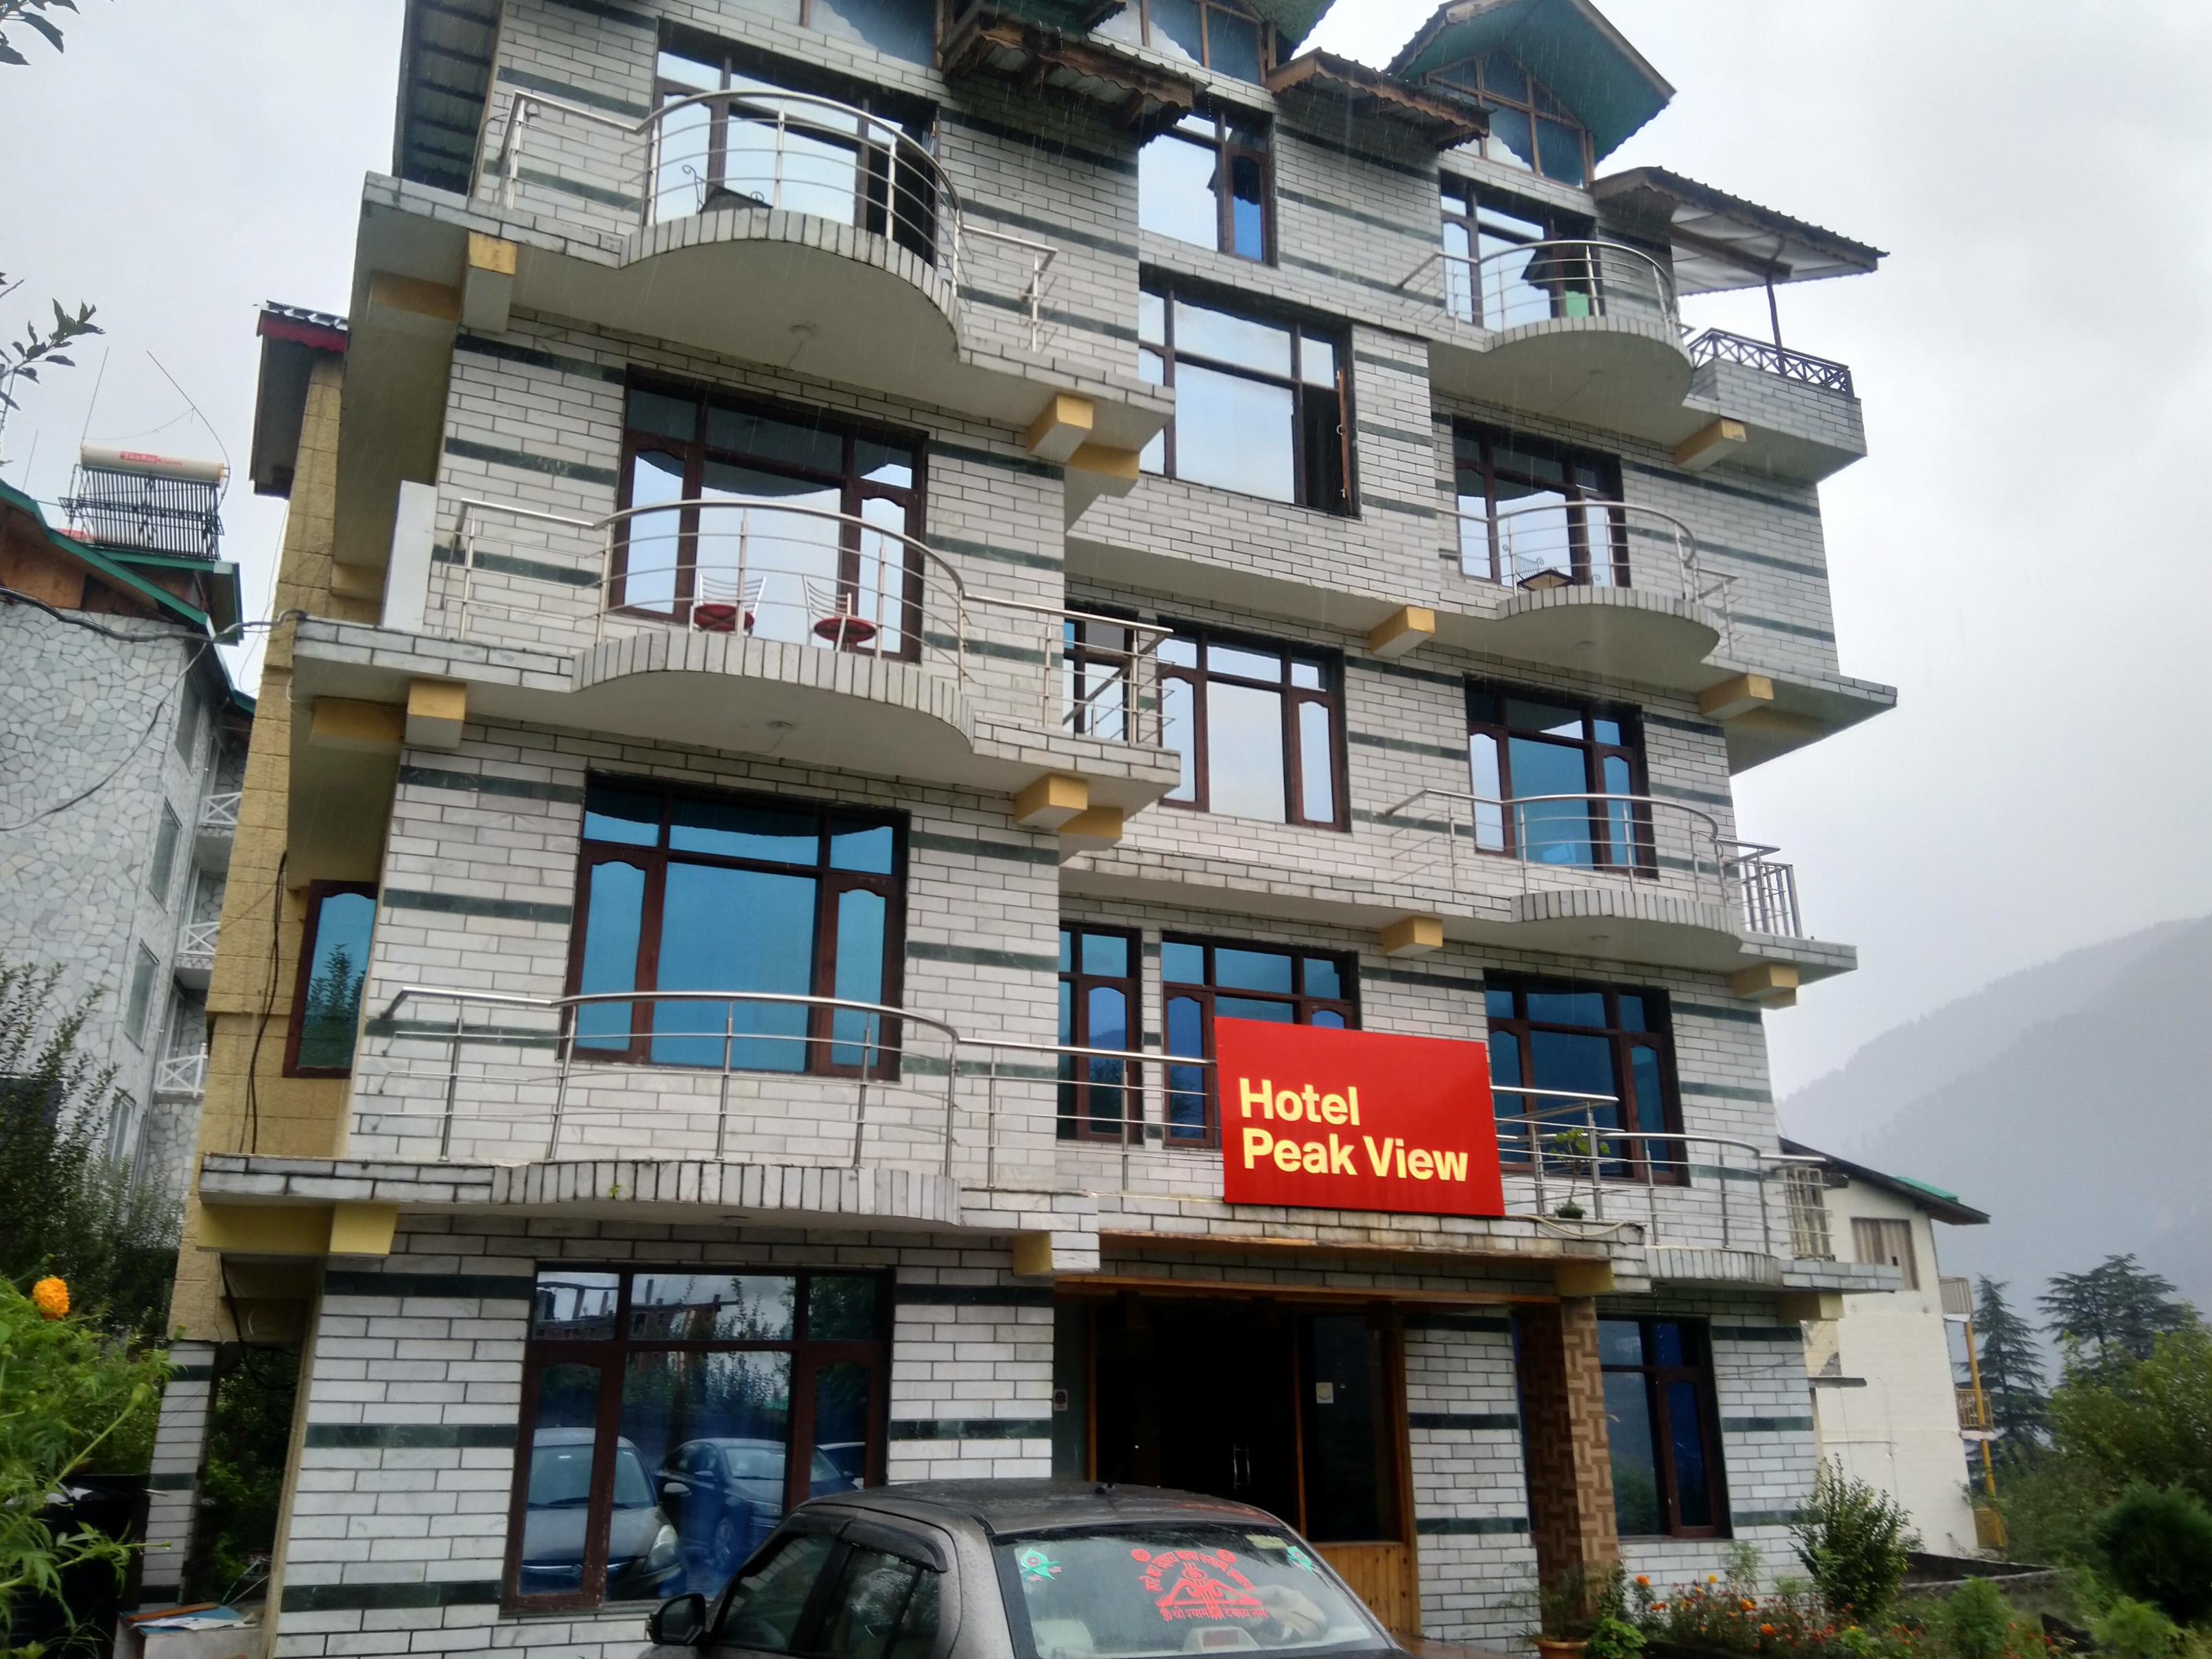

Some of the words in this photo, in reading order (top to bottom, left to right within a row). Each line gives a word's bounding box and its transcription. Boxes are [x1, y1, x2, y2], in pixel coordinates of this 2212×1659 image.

[1239, 1077, 1360, 1125] Hotel
[1242, 1127, 1357, 1175] Peak
[1362, 1136, 1468, 1182] View
